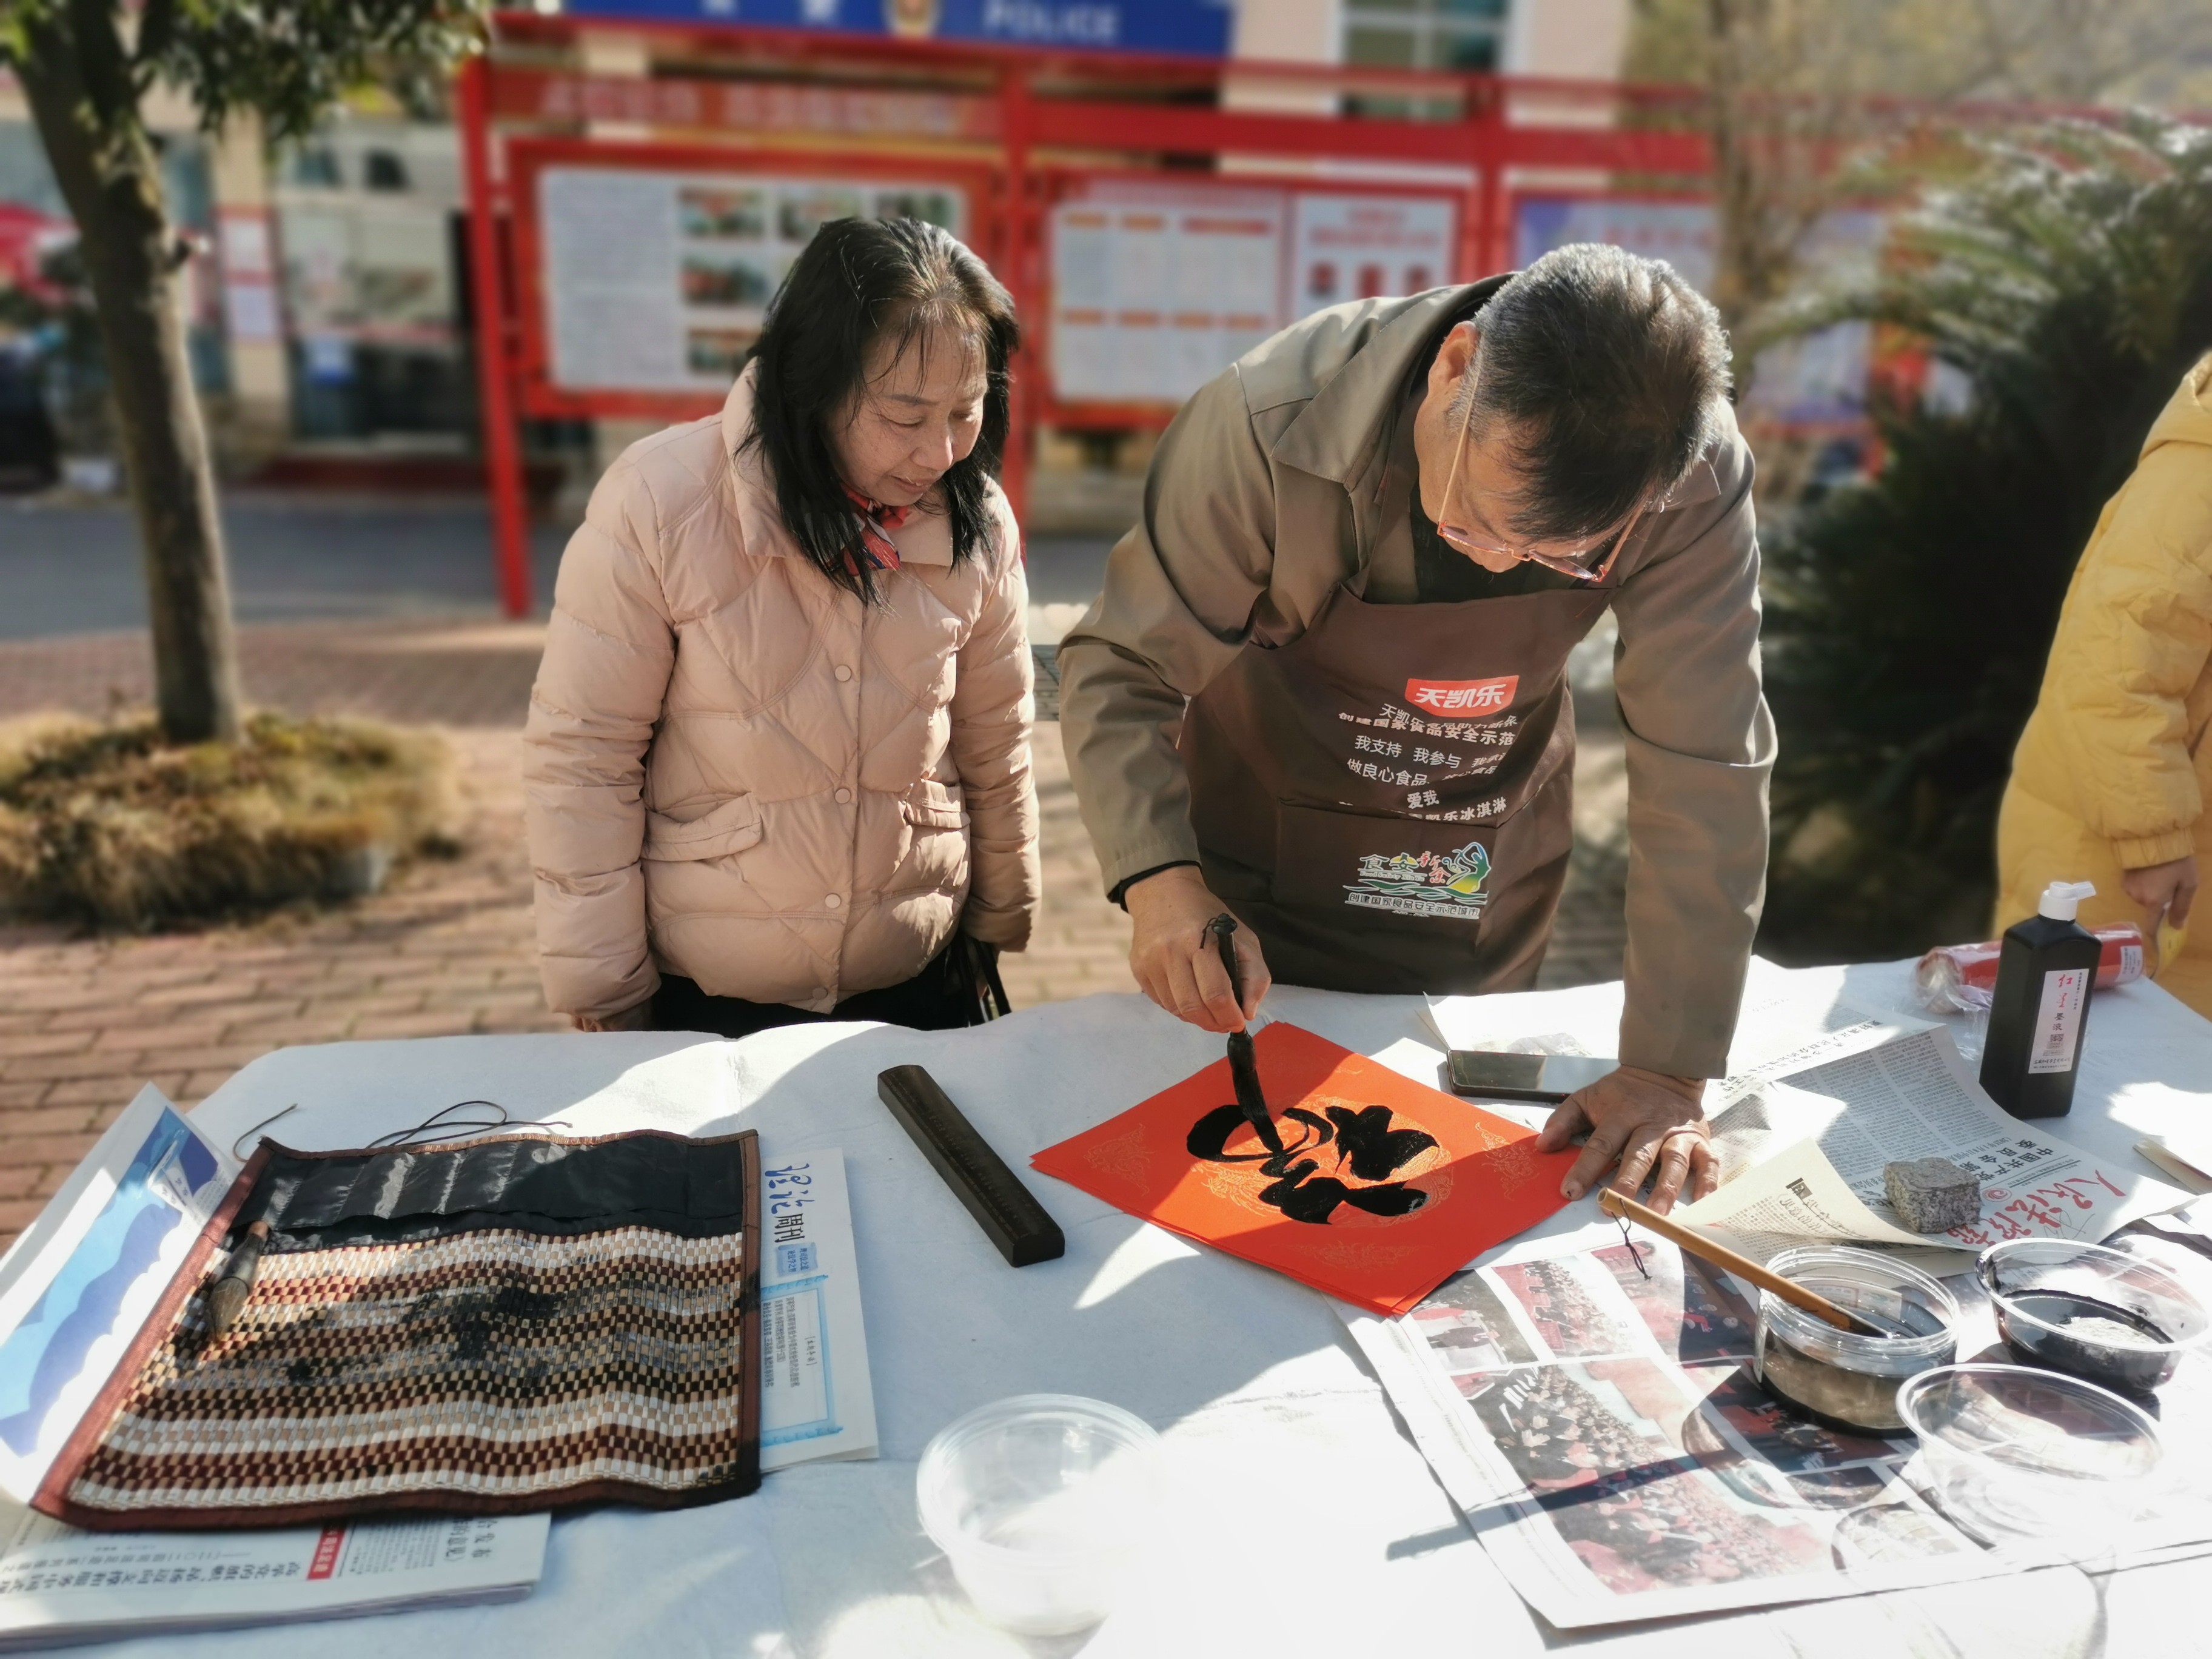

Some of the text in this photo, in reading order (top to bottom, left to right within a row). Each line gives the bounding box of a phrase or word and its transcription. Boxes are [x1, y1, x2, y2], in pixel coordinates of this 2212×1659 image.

[984, 1, 1118, 45] POLICE
[1415, 683, 1506, 708] 天凯乐
[1355, 735, 1403, 758] 我支持
[1413, 747, 1462, 769] 我参与
[1347, 758, 1429, 787] 做良心食品
[1407, 789, 1440, 809] 爱我
[1409, 796, 1507, 822] 凯乐冰淇淋
[1348, 892, 1480, 917] 创建国家食品安全示范城市
[1959, 1139, 2038, 1173] 委员会第
[1974, 1147, 2054, 1182] 中国共产党
[1946, 1169, 2127, 1247] 人民法院报
